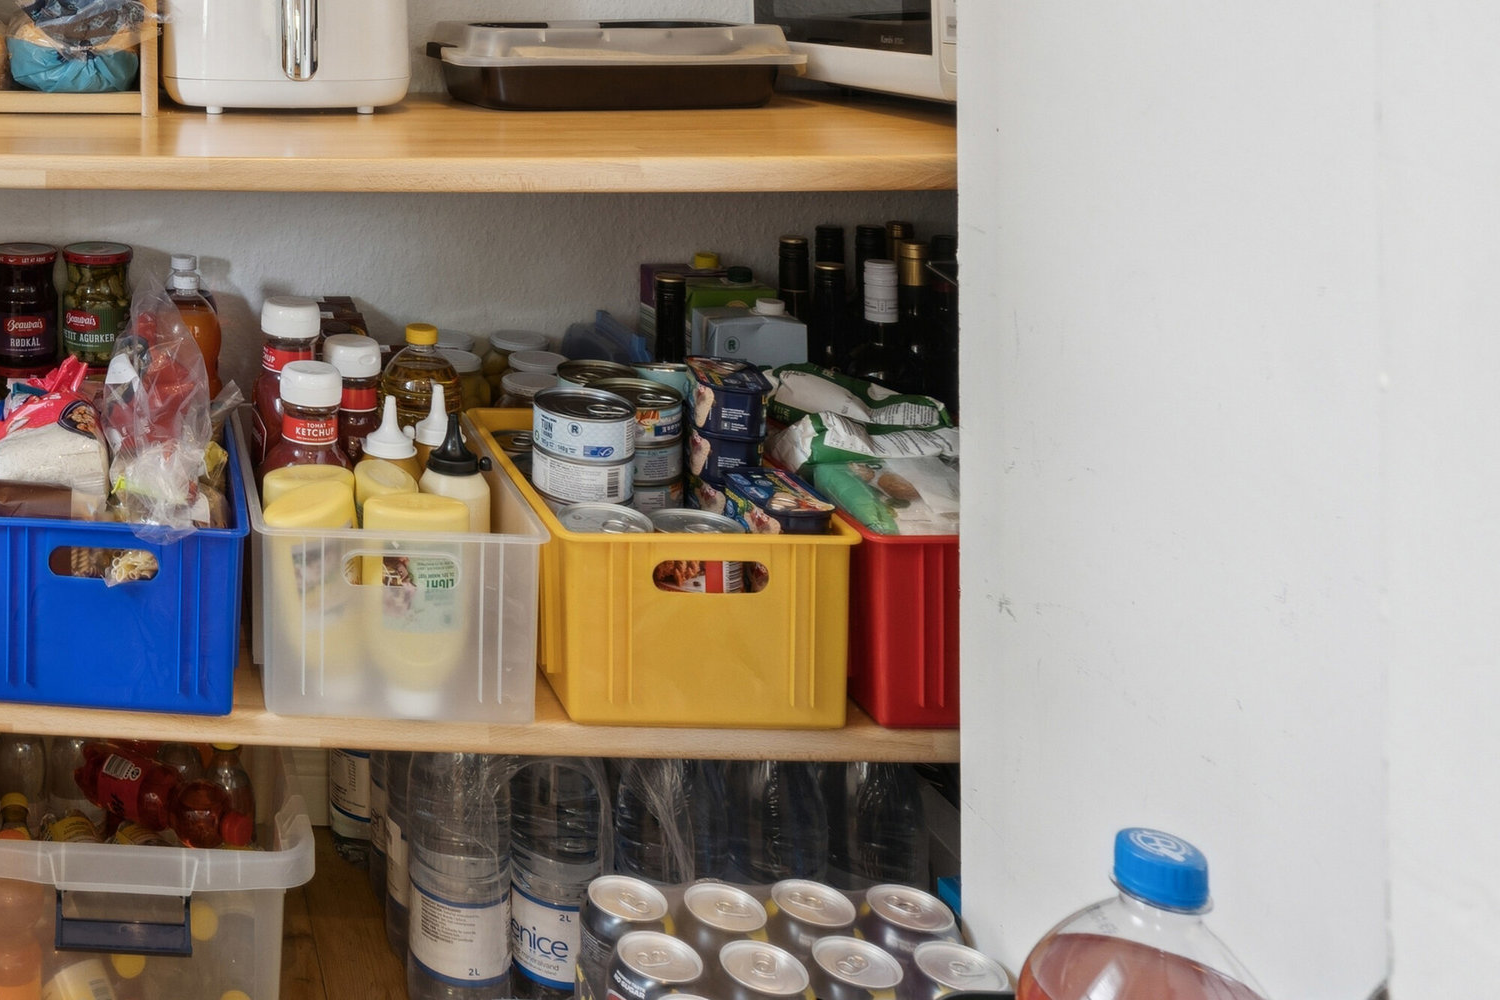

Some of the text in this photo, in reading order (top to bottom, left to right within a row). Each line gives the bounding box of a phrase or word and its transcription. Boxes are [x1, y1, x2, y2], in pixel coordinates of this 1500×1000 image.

[66, 312, 96, 326] Beauvais
[7, 318, 43, 332] Beauvais
[10, 337, 41, 347] RØDKÅL
[79, 333, 115, 343] AGURKER
[541, 418, 553, 433] TUN
[295, 427, 334, 437] KETCHUP
[559, 914, 572, 923] 2L
[468, 968, 480, 977] 2L
[621, 981, 646, 999] SUGAR
